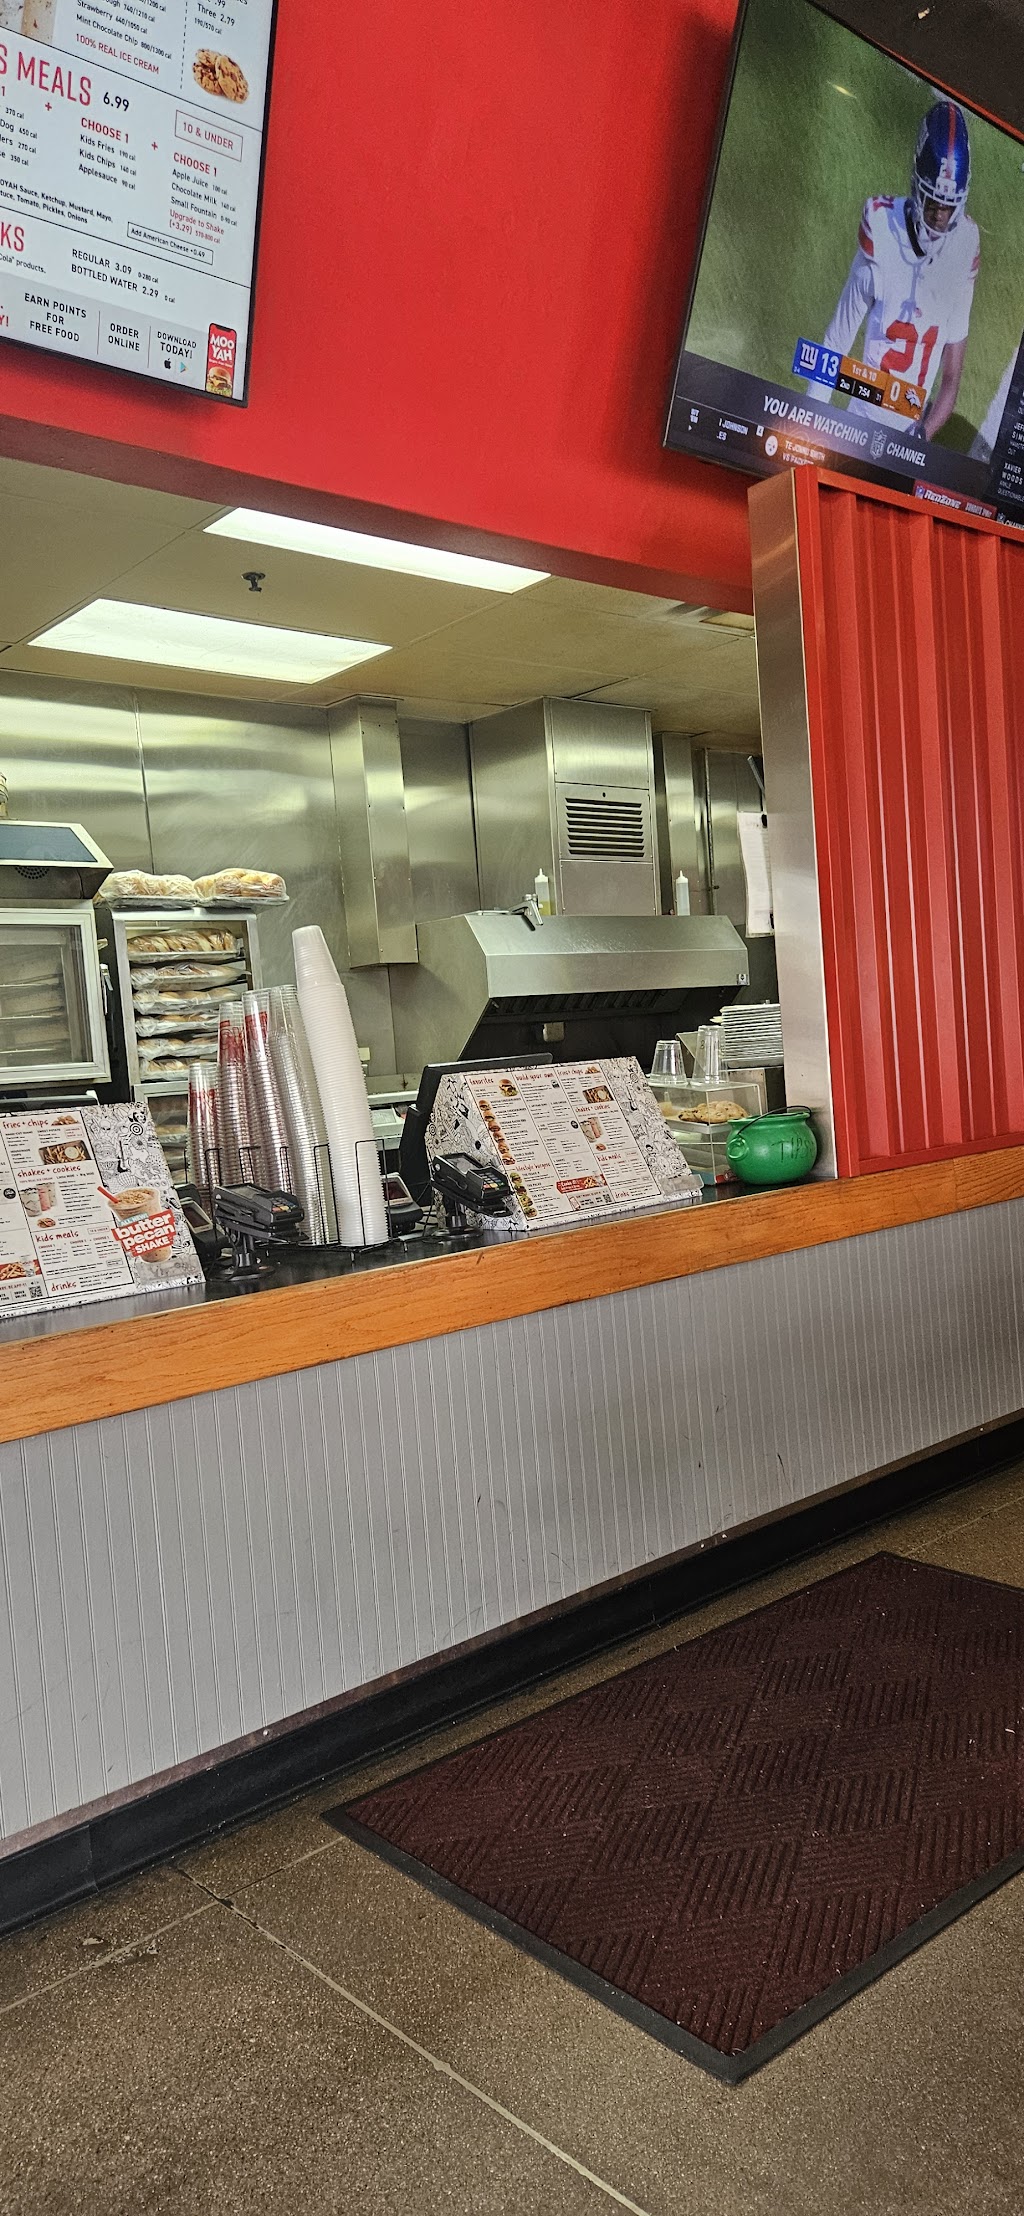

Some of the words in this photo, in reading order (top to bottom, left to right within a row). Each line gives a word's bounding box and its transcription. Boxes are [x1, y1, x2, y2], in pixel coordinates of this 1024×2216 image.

[77, 0, 113, 20] Strawberry
[197, 2, 217, 19] Three
[219, 13, 235, 27] 2.79
[76, 13, 91, 27] Mint
[92, 20, 123, 39] Chocolate
[124, 34, 138, 46] Chip
[75, 33, 97, 49] 100%
[98, 42, 118, 58] REAL
[119, 50, 132, 63] ICE
[133, 57, 160, 74] CREAM
[17, 51, 93, 108] MEALS
[102, 91, 130, 113] 6.99
[80, 117, 122, 142] CHOOSE
[124, 133, 130, 144] 1
[182, 121, 193, 135] 10
[194, 127, 203, 138] &
[204, 130, 235, 151] UNDER
[79, 133, 96, 148] Kids
[96, 140, 115, 154] Fries
[79, 148, 95, 162] Kids
[96, 155, 116, 170] Chips
[172, 152, 211, 176] CHOOSE
[212, 166, 218, 178] 1
[78, 163, 118, 185] Applesauce
[171, 168, 191, 183] Apple
[191, 177, 209, 189] Juice
[18, 185, 40, 199] Sauce,
[40, 192, 68, 208] Ketchup,
[68, 201, 96, 217] Mustard,
[171, 182, 203, 201] Chocolate
[203, 194, 218, 206] Milk
[16, 194, 42, 210] Tomato,
[42, 203, 66, 218] Pickles,
[66, 211, 89, 224] Onions
[170, 196, 190, 209] Small
[189, 203, 218, 220] Fountain
[168, 219, 194, 235] (+3.29)
[169, 208, 198, 226] Upgrade
[197, 219, 206, 228] to
[205, 222, 226, 236] Shake
[130, 227, 142, 237] Add
[142, 231, 170, 246] American
[169, 240, 190, 254] Cheese
[71, 247, 111, 269] REGULAR
[114, 262, 132, 275] 3.09
[71, 263, 109, 283] BOTTLED
[108, 275, 139, 293] WATER
[141, 285, 160, 299] 2.29
[24, 292, 51, 308] EARN
[52, 300, 88, 319] POINTS
[46, 312, 65, 326] FOR
[29, 320, 54, 335] FREE
[54, 327, 80, 343] FOOD
[109, 322, 140, 340] ORDER
[157, 330, 198, 350] DOWNLOAD
[209, 333, 235, 351] MOO
[107, 335, 141, 352] ONLINE
[160, 341, 194, 360] TODAY!
[211, 345, 234, 362] YAH
[880, 320, 939, 389] 21
[821, 352, 840, 378] 13
[868, 370, 878, 383] 10
[889, 380, 902, 403] 0
[763, 394, 790, 419] YOU
[787, 405, 815, 428] ARE
[813, 415, 870, 448] WATCHING
[885, 440, 927, 468] CHANNEL
[1001, 471, 1024, 486] WOODS
[1003, 462, 1023, 475] XAVIER
[2, 1120, 21, 1130] fries
[27, 1118, 49, 1129] chips
[17, 1167, 46, 1178] shakes
[52, 1164, 82, 1174] cookies
[35, 1232, 55, 1243] kids
[55, 1229, 80, 1240] meals
[114, 1213, 172, 1240] butter
[122, 1223, 175, 1250] pecan
[135, 1236, 171, 1254] SHAKE
[51, 1280, 77, 1292] drinks
